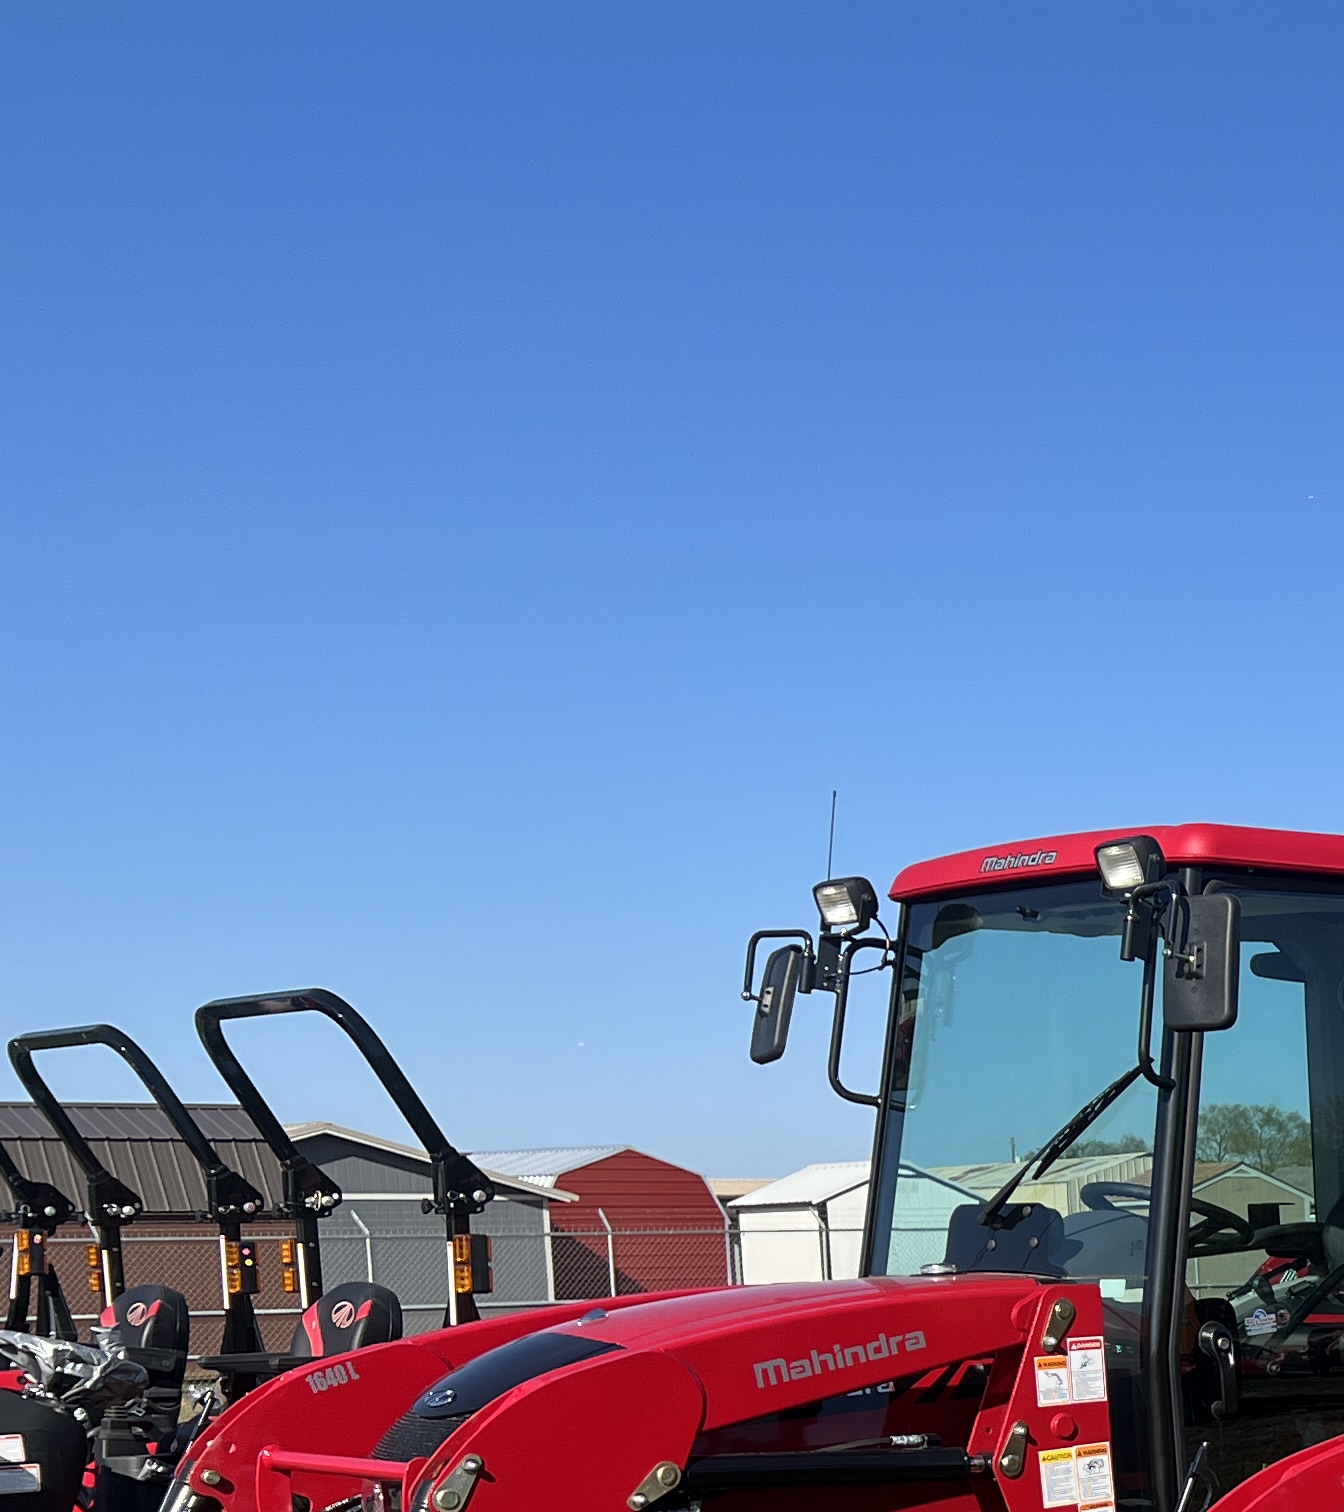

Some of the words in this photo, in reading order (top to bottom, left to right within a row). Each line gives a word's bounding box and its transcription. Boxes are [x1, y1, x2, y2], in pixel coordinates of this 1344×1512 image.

[979, 850, 1058, 873] Mahindra
[753, 1330, 926, 1389] Mahindra
[305, 1364, 348, 1393] 1640
